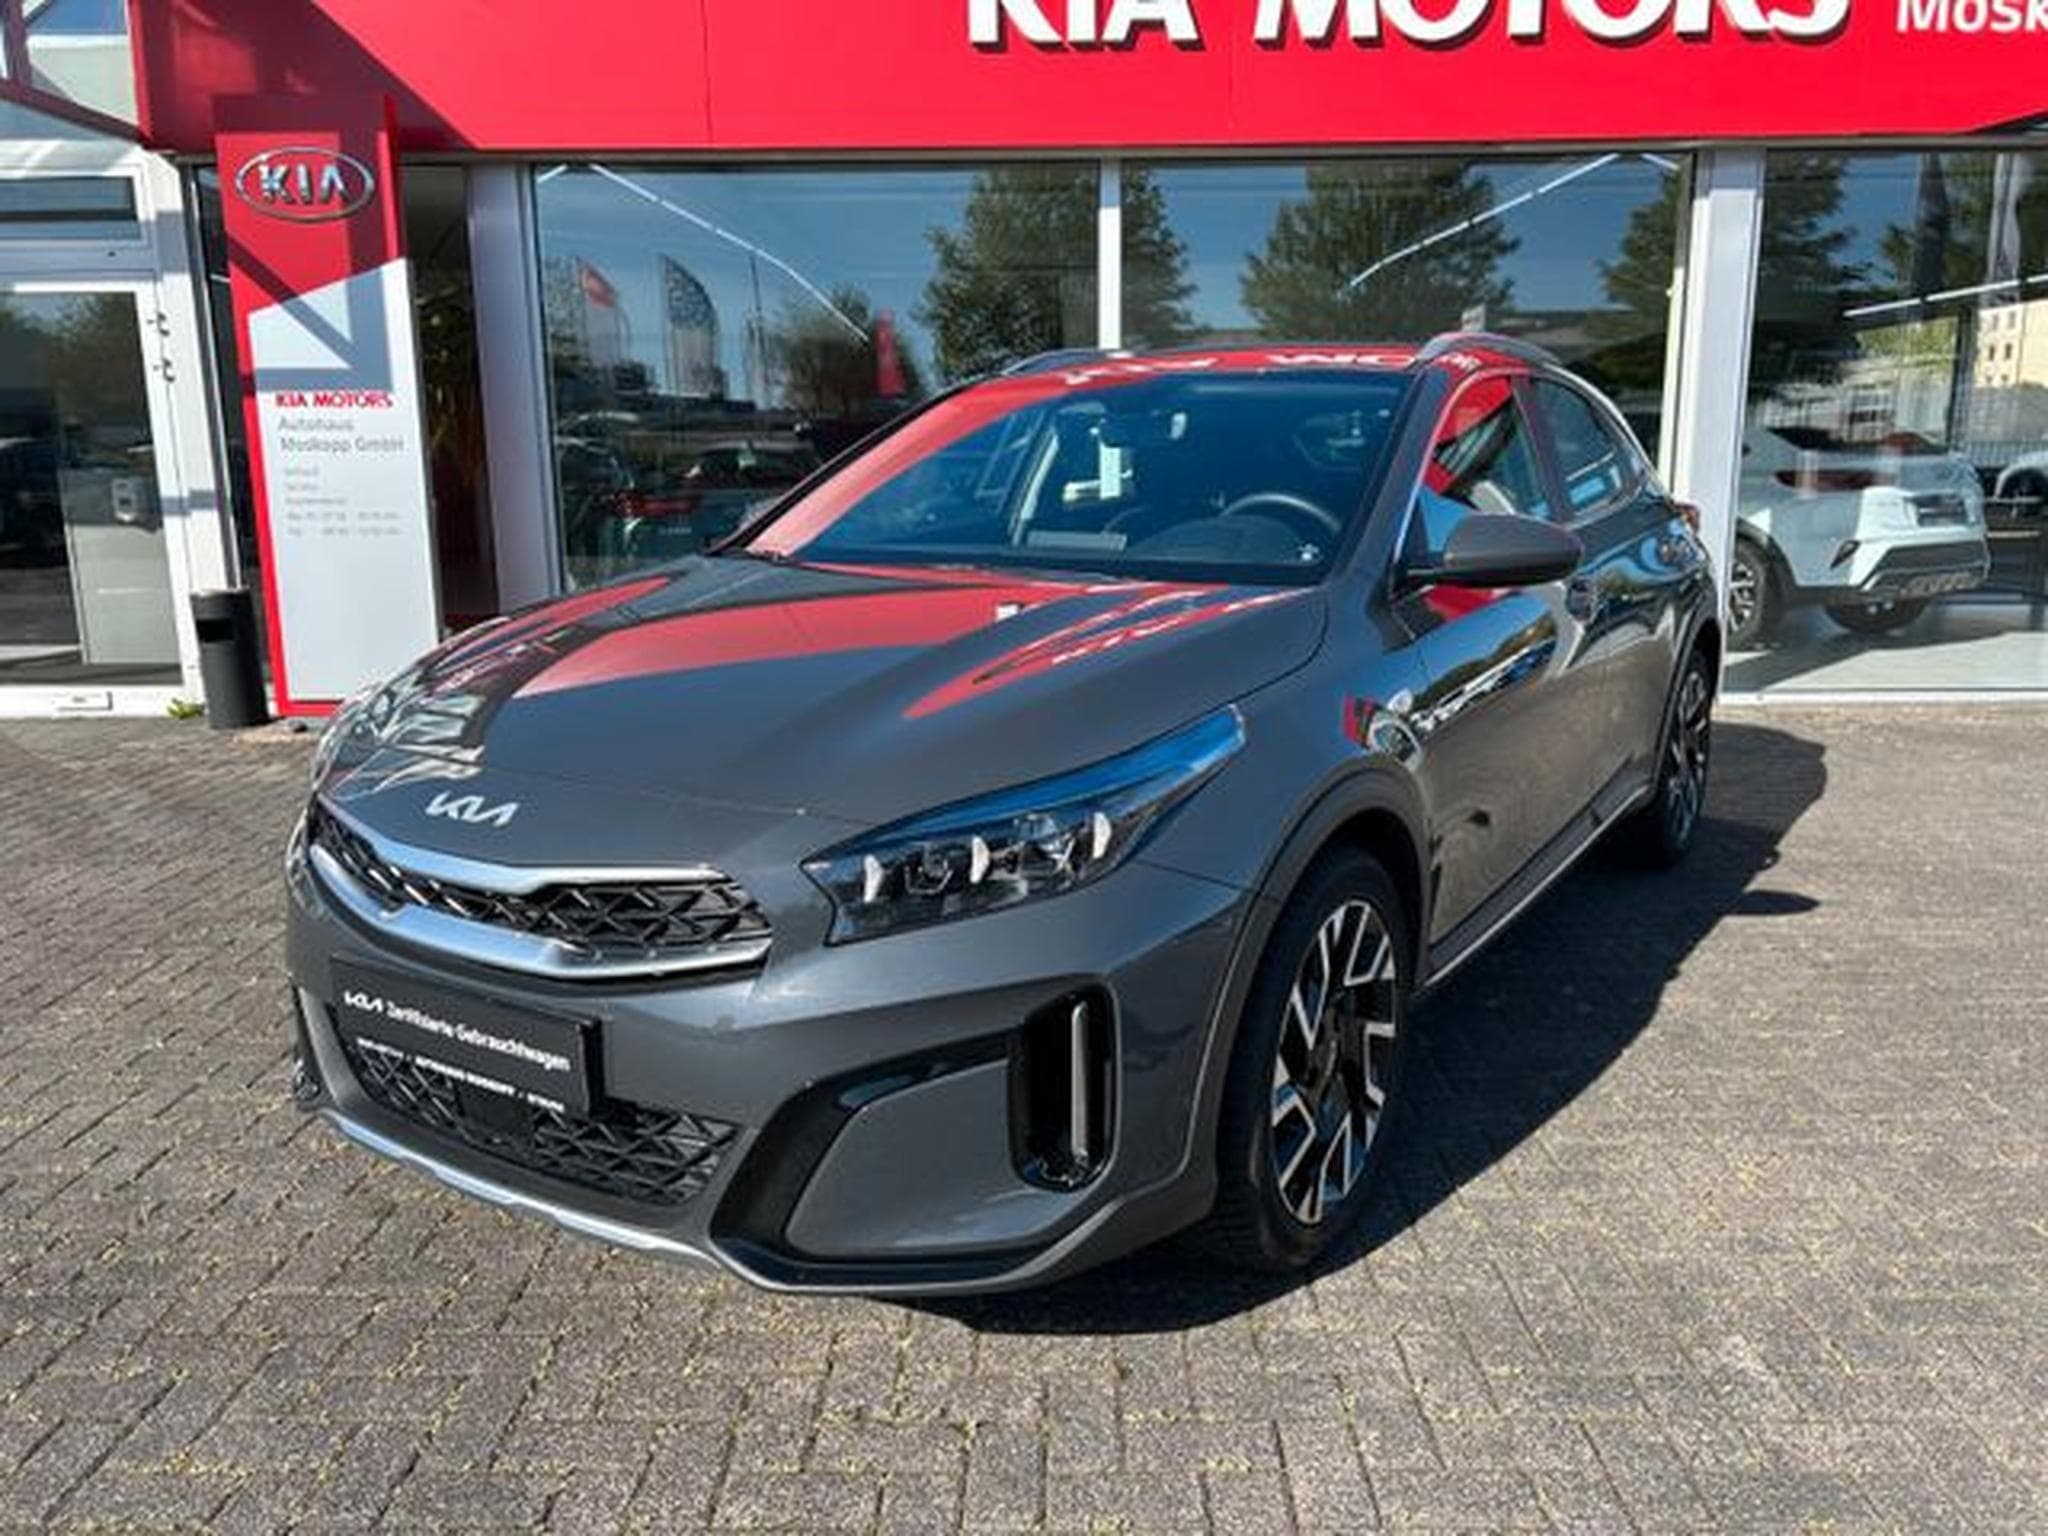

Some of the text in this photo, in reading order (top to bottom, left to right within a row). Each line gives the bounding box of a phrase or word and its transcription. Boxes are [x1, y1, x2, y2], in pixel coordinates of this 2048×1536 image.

[967, 0, 1203, 50] KIA
[258, 163, 348, 203] KIA
[276, 390, 393, 407] KIA MOTORS
[278, 417, 355, 431] Autohaus
[281, 437, 404, 453] Moskopp GmbH
